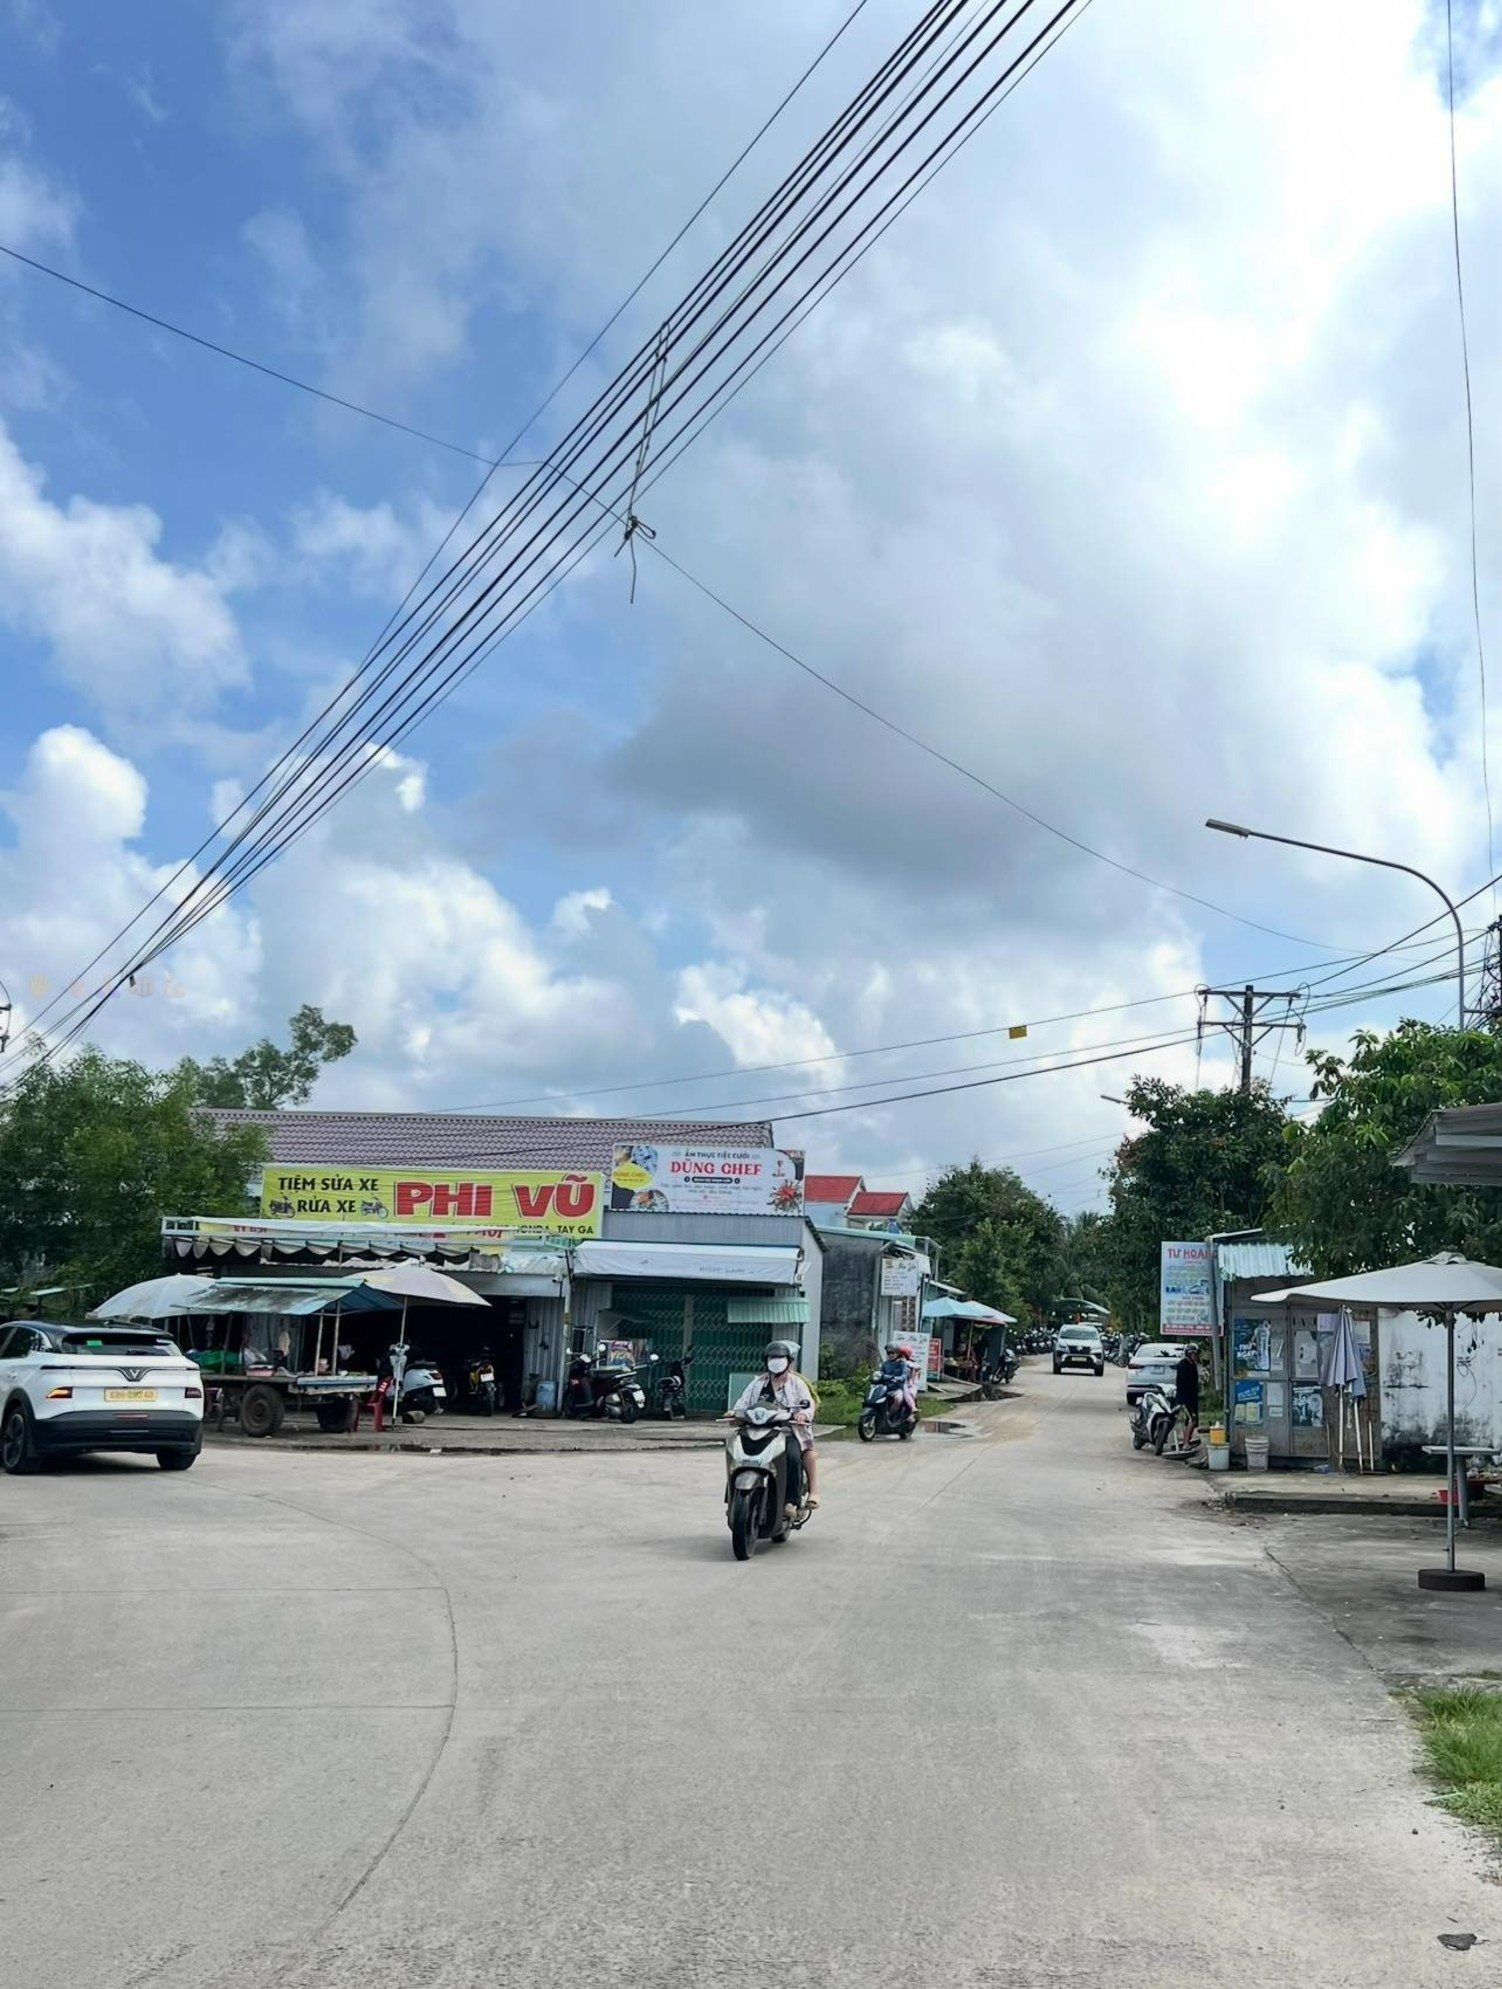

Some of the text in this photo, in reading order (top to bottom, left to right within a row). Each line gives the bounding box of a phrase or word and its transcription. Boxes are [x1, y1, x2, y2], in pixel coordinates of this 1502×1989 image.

[671, 1158, 763, 1175] DŨNG CHEF
[278, 1174, 379, 1193] TIỆM SỬA XE
[297, 1195, 356, 1213] RỬA XE
[394, 1173, 595, 1218] PHI VŨ
[557, 1225, 575, 1234] TAY
[578, 1225, 594, 1234] GA
[1167, 1248, 1182, 1259] TƯ
